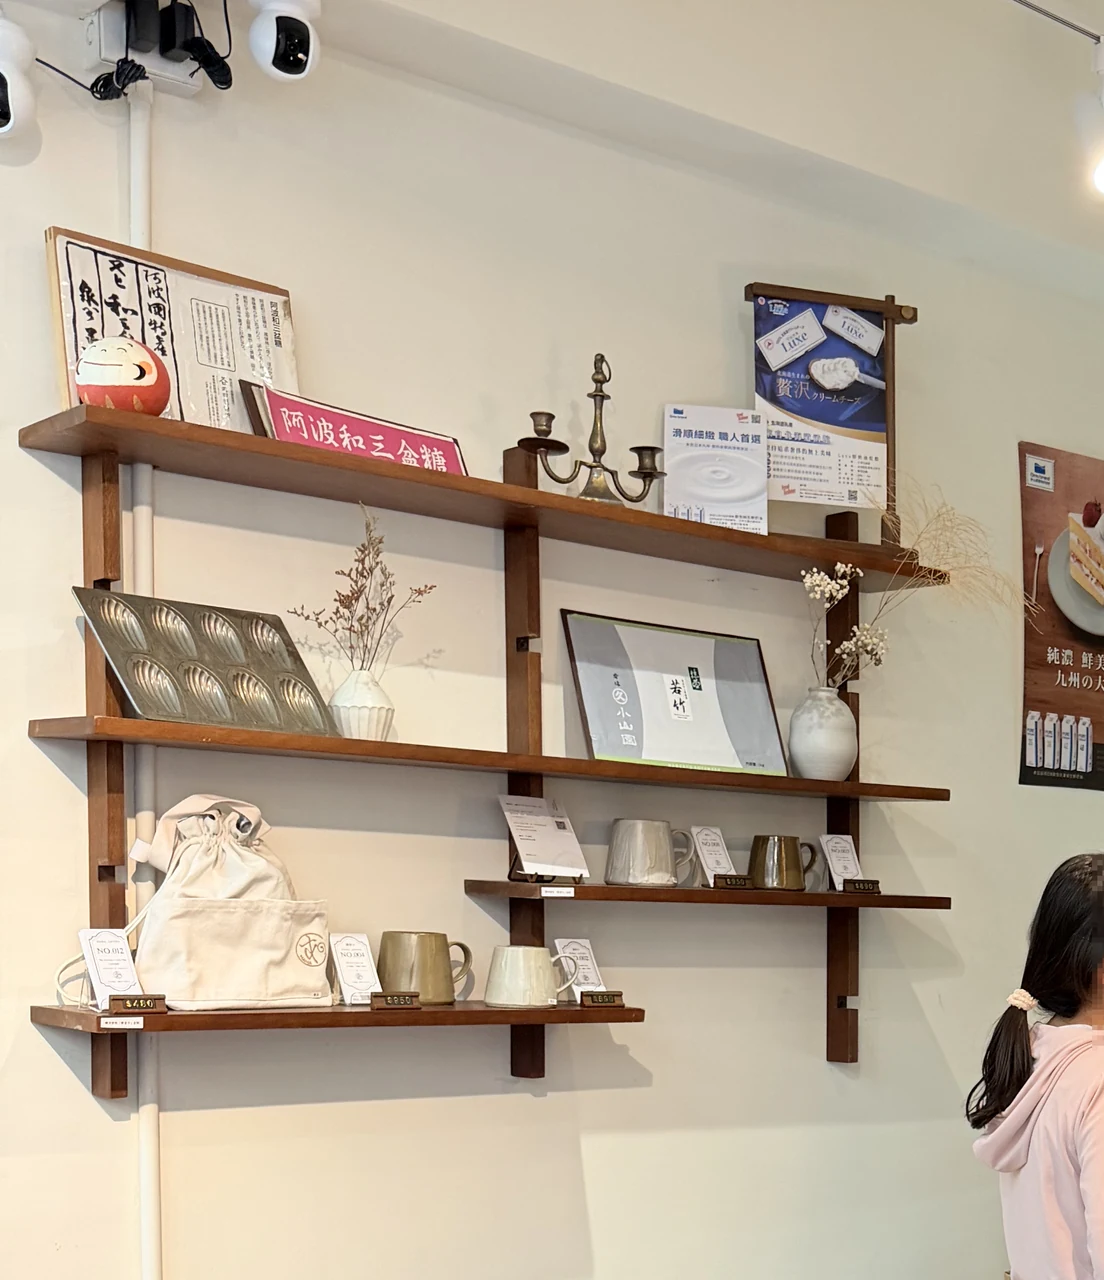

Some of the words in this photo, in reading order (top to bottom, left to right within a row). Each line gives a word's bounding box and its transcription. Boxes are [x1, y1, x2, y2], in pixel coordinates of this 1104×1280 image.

[781, 332, 809, 353] Luxe
[280, 407, 447, 473] 阿波和三盆糖
[1046, 646, 1074, 667] 純濃
[669, 678, 687, 714] 若竹
[96, 947, 125, 955] NO.012
